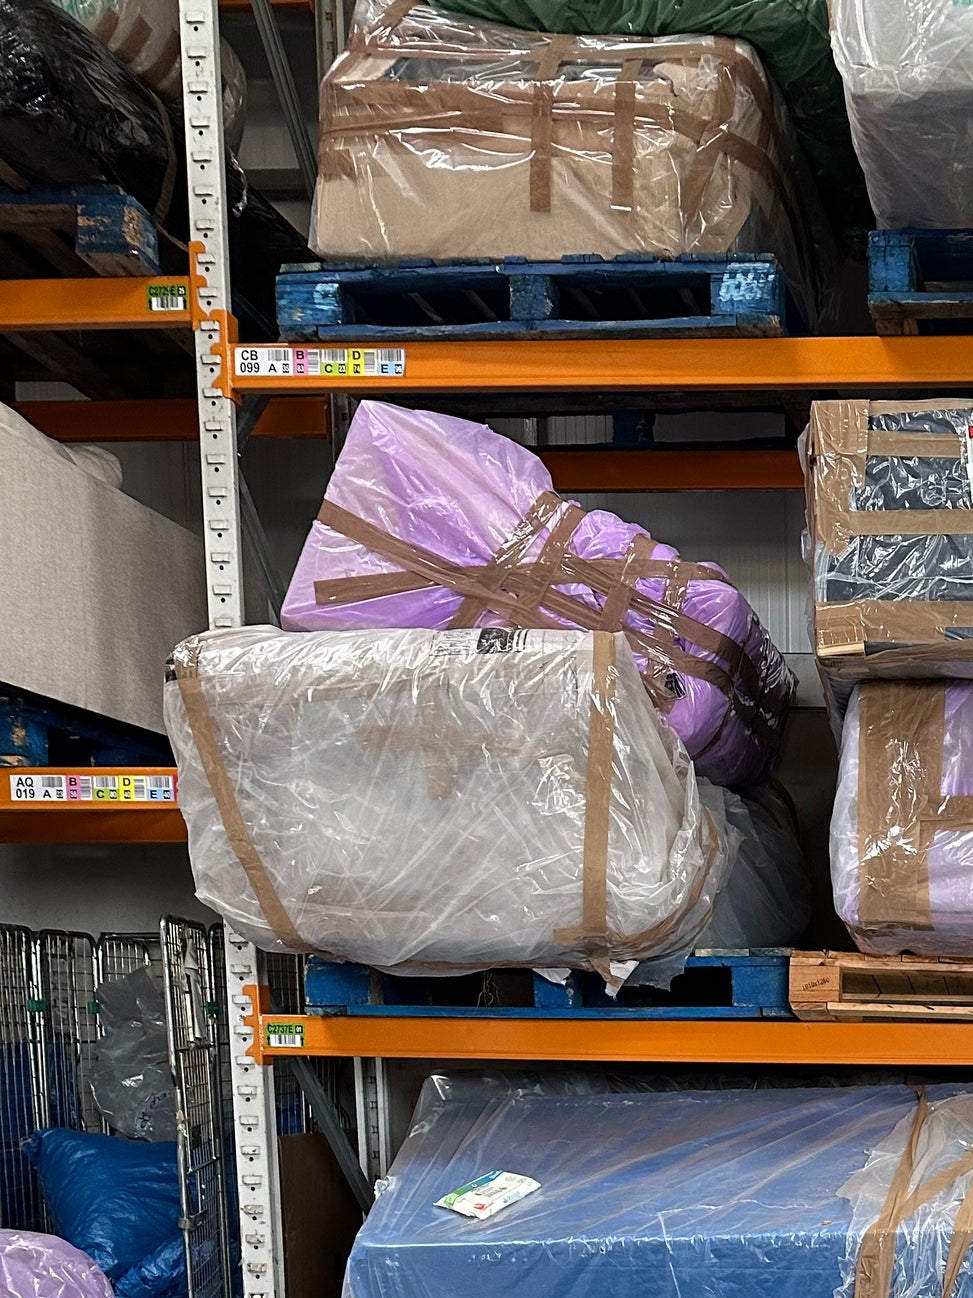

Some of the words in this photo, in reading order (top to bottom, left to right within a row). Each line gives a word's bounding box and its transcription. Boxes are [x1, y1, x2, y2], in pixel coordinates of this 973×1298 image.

[241, 350, 258, 360] CB
[296, 351, 304, 360] B
[353, 351, 360, 360] D
[240, 363, 260, 373] 099
[268, 364, 277, 372] A
[324, 364, 332, 372] C
[381, 364, 388, 373] E
[16, 777, 34, 788] AQ
[123, 778, 130, 786] D
[16, 789, 35, 798] 019
[43, 790, 51, 798] A
[96, 790, 104, 798] C
[150, 790, 157, 799] E
[268, 1024, 293, 1034] C2737E
